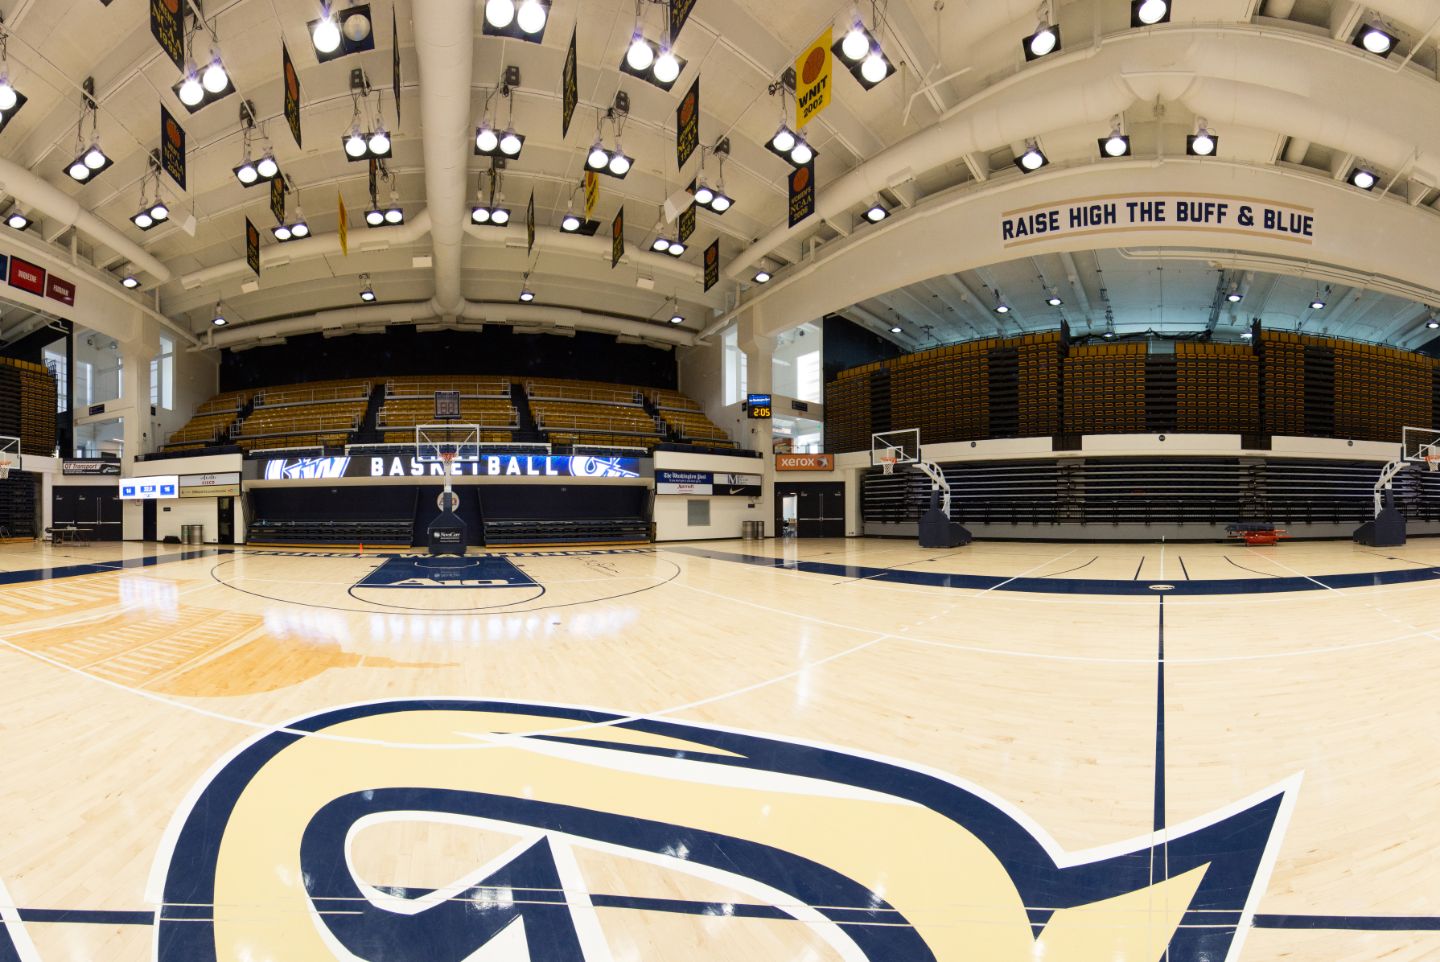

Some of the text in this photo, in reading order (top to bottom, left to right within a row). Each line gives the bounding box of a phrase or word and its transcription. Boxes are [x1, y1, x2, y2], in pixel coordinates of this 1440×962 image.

[798, 75, 828, 108] WNIT
[803, 95, 823, 118] 2002
[1002, 201, 1314, 240] RAISE HIGH THE BUFF & BLUE
[753, 407, 771, 417] 2:05
[370, 456, 558, 476] BASKETBALL
[781, 457, 816, 467] xerox
[671, 472, 697, 480] Washington
